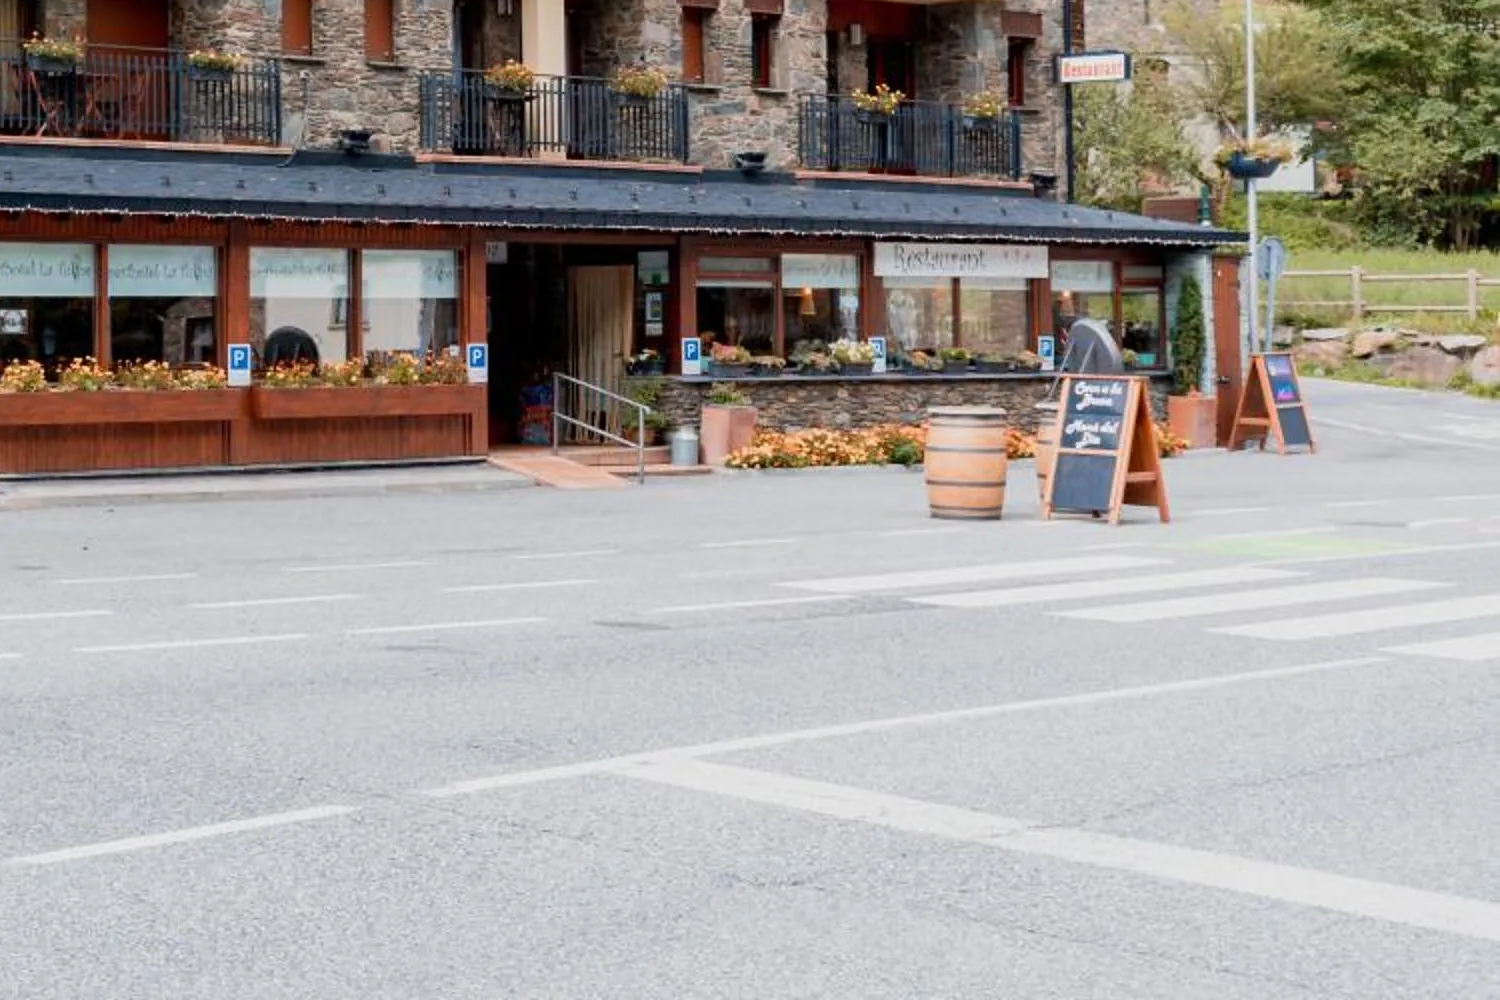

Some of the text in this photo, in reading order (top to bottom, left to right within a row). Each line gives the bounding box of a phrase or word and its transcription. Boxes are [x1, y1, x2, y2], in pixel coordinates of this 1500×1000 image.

[893, 243, 986, 271] Restaurant
[234, 350, 245, 367] P
[471, 349, 482, 365] P
